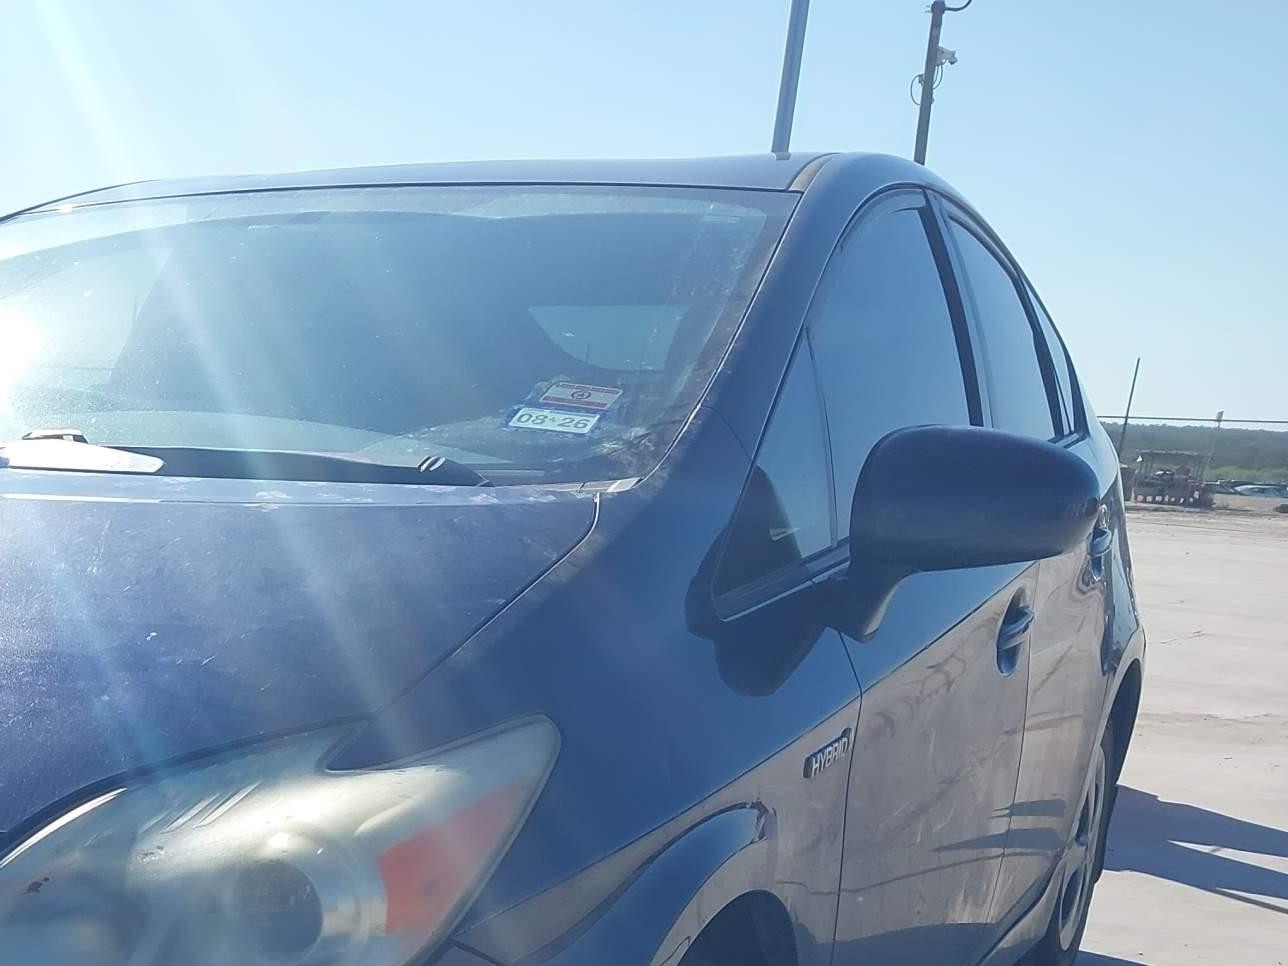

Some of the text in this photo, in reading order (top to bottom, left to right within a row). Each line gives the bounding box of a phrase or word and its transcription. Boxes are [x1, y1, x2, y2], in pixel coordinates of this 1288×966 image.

[517, 413, 591, 429] 08 26
[811, 737, 848, 777] HYBRID
